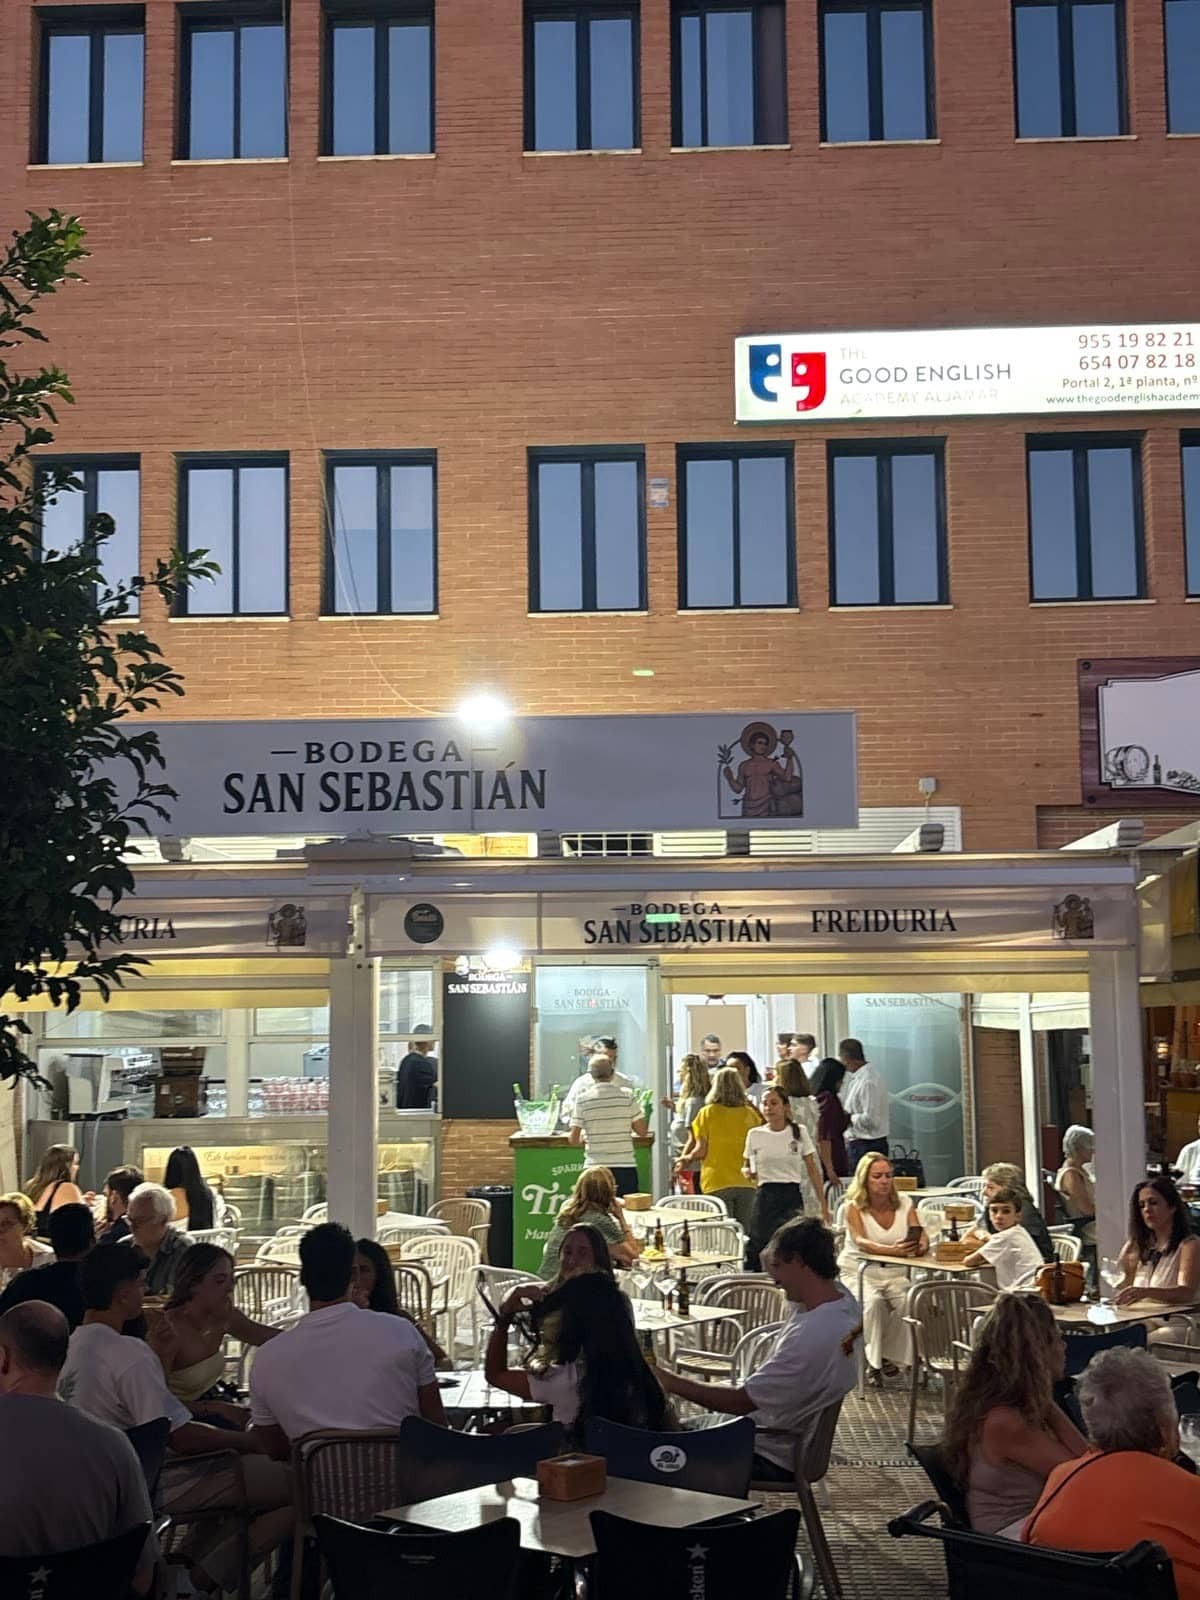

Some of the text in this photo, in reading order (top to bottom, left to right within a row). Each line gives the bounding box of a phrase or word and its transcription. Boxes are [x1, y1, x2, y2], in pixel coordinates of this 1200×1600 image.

[1078, 332, 1195, 349] 955 19 82 21
[1079, 353, 1196, 370] 654 07 82 18
[839, 363, 1012, 384] GOOD ENGLISH
[1062, 377, 1099, 389] Portal
[1104, 377, 1114, 389] 2,
[1136, 376, 1180, 389] planta,
[1046, 392, 1200, 405] www.thegoodenglishacadem
[304, 740, 463, 764] BODEGA
[223, 761, 547, 815] SAN SEBASTIÁN
[631, 902, 722, 916] BODEGA
[584, 908, 958, 943] SAN SEBASTIÁN FREIDURIA
[447, 983, 469, 994] SAN
[554, 999, 574, 1009] SAN
[864, 997, 886, 1007] SAN
